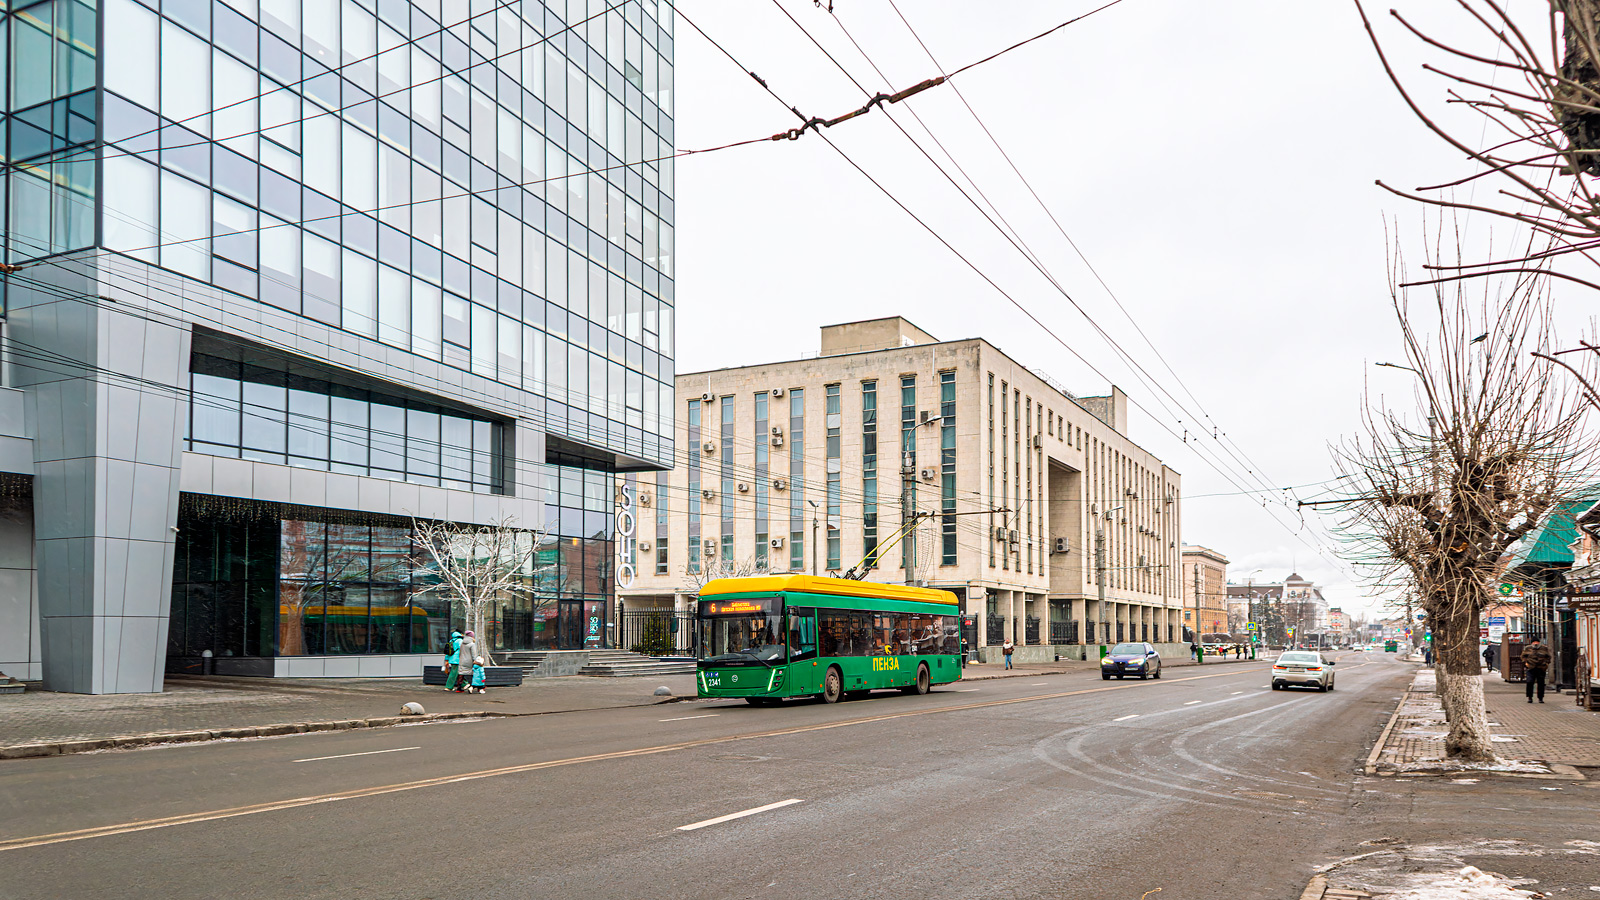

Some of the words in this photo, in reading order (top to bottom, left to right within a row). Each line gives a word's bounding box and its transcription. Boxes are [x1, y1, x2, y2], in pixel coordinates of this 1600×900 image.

[616, 484, 635, 589] SOHO
[711, 603, 717, 613] 6
[872, 657, 900, 671] ПЕНЗА
[708, 678, 721, 687] 2341
